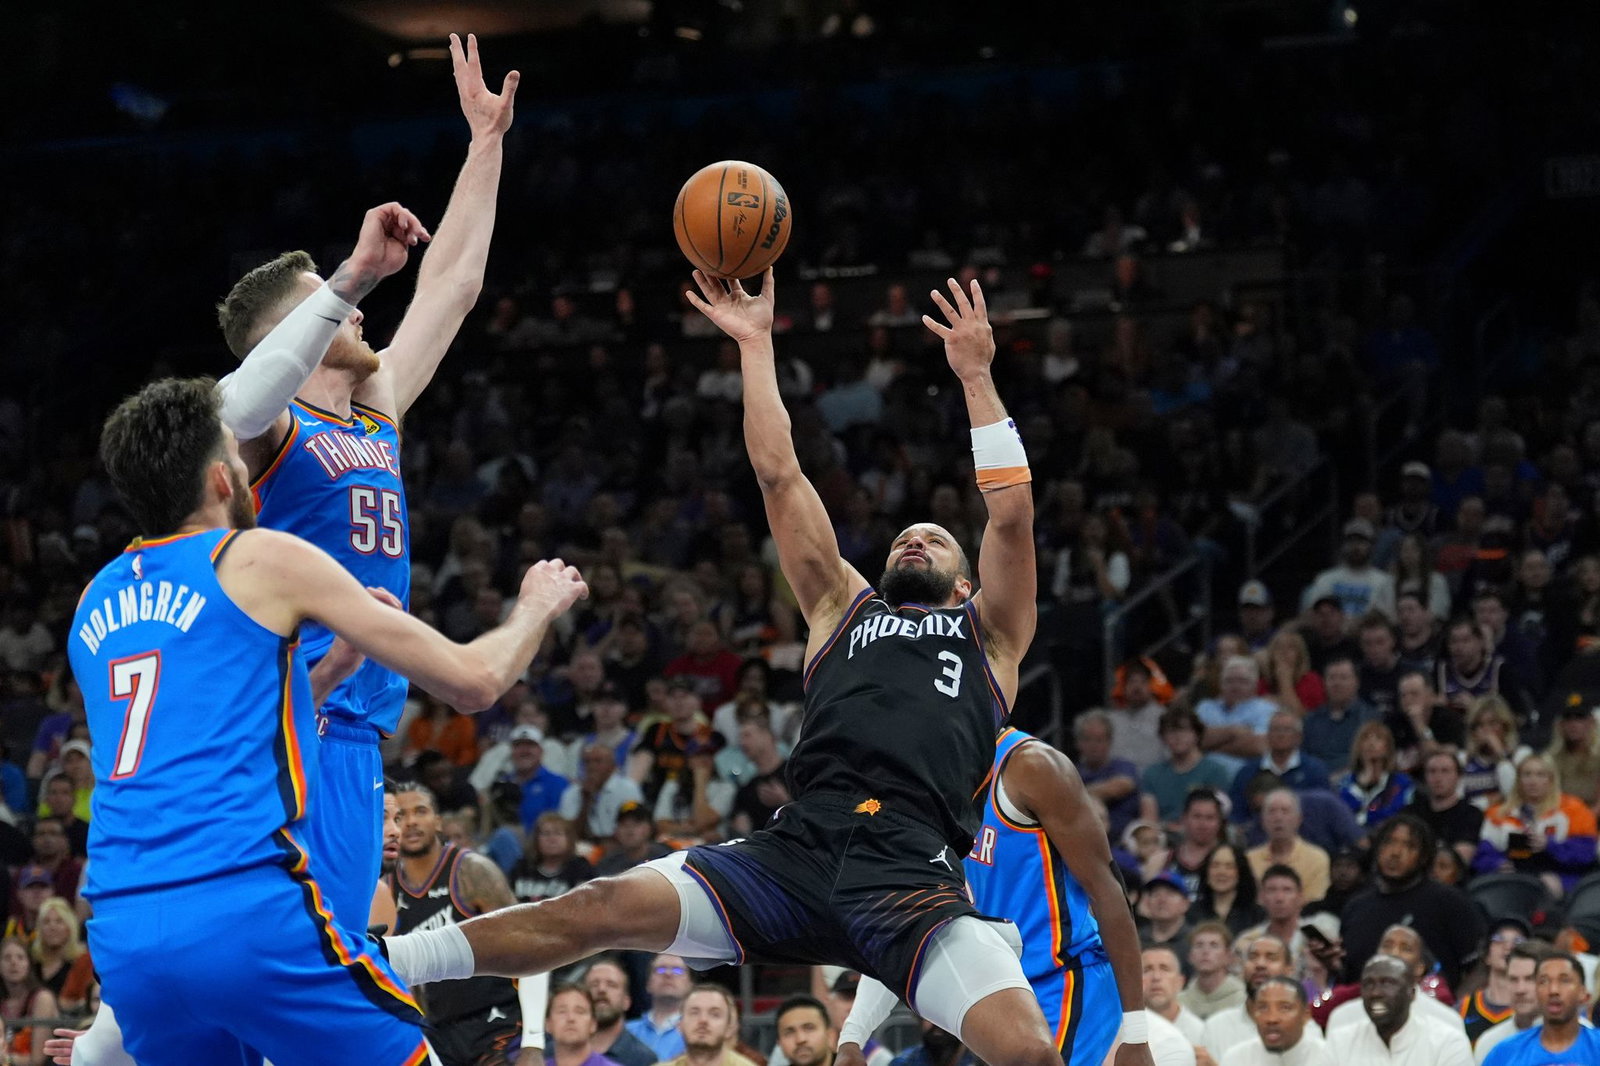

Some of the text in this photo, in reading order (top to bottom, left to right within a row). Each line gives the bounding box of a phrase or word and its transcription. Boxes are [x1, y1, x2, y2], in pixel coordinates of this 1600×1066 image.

[304, 430, 400, 480] THUNDE
[350, 485, 403, 558] 55
[79, 581, 206, 656] HOLMGREN
[847, 614, 967, 660] PHOENIX
[933, 650, 963, 698] 3
[108, 649, 161, 780] 7
